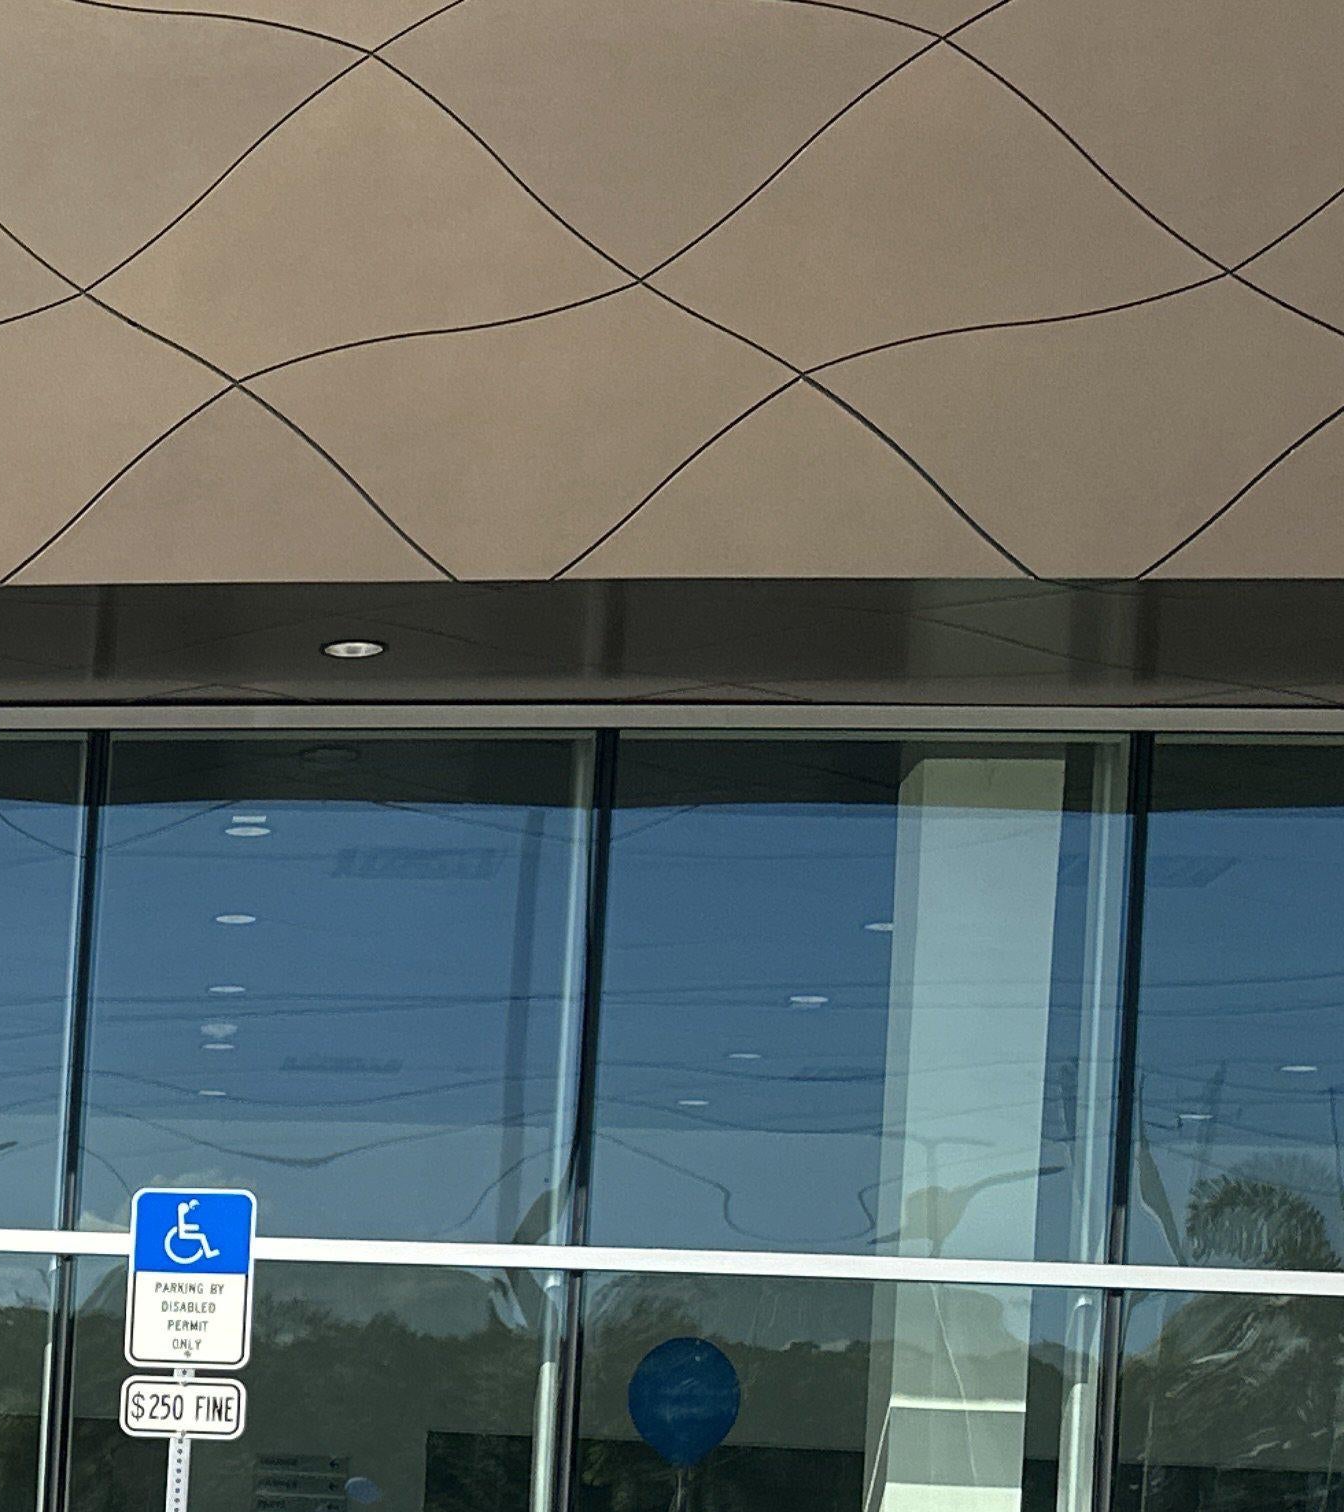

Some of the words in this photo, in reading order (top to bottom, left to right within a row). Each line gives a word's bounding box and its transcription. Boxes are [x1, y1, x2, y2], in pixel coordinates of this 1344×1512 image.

[155, 1281, 203, 1294] PARKING
[210, 1283, 224, 1294] BY
[161, 1300, 216, 1313] DISABLED
[168, 1319, 208, 1331] PERMIT
[172, 1338, 202, 1350] ONLY
[131, 1391, 184, 1421] $250
[196, 1396, 235, 1422] FINE
